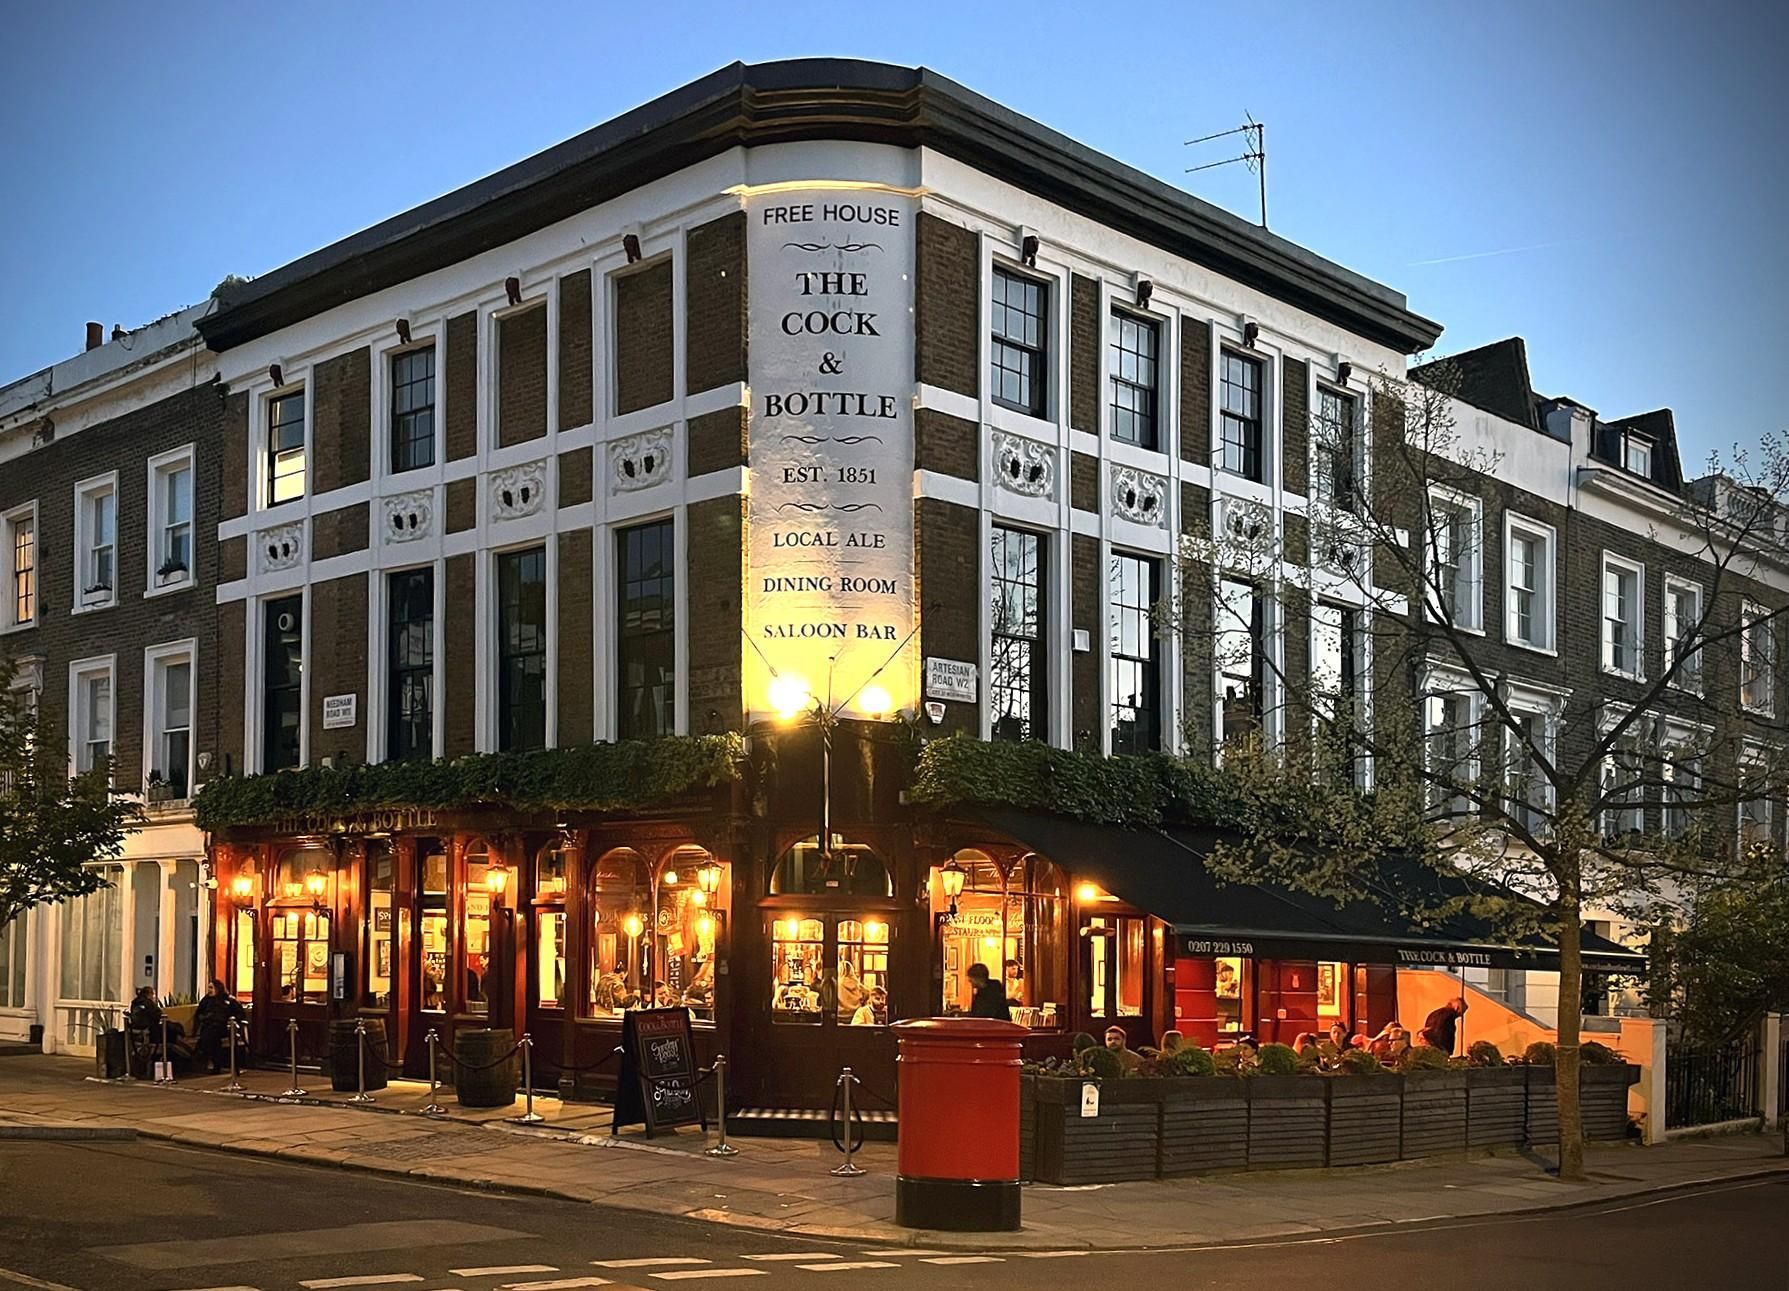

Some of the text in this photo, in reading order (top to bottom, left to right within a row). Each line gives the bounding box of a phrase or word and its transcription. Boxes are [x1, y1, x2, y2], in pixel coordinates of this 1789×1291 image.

[763, 204, 900, 227] FREE HOUSE
[795, 272, 869, 297] THE
[781, 310, 881, 337] COCK
[818, 351, 844, 375] &
[764, 392, 898, 419] BOTTLE
[783, 466, 877, 484] EST. 1851
[773, 531, 886, 549] LOCAL ALE
[763, 577, 897, 595] DINING ROOM
[763, 623, 897, 641] SALOON BAR
[932, 662, 970, 677] ARTESIAN
[932, 674, 969, 689] ROAD W2
[373, 806, 438, 831] BOTTLE
[1188, 940, 1211, 953] 0207
[1231, 942, 1253, 954] 1550
[1397, 950, 1492, 965] THE COCK & BOTTLE
